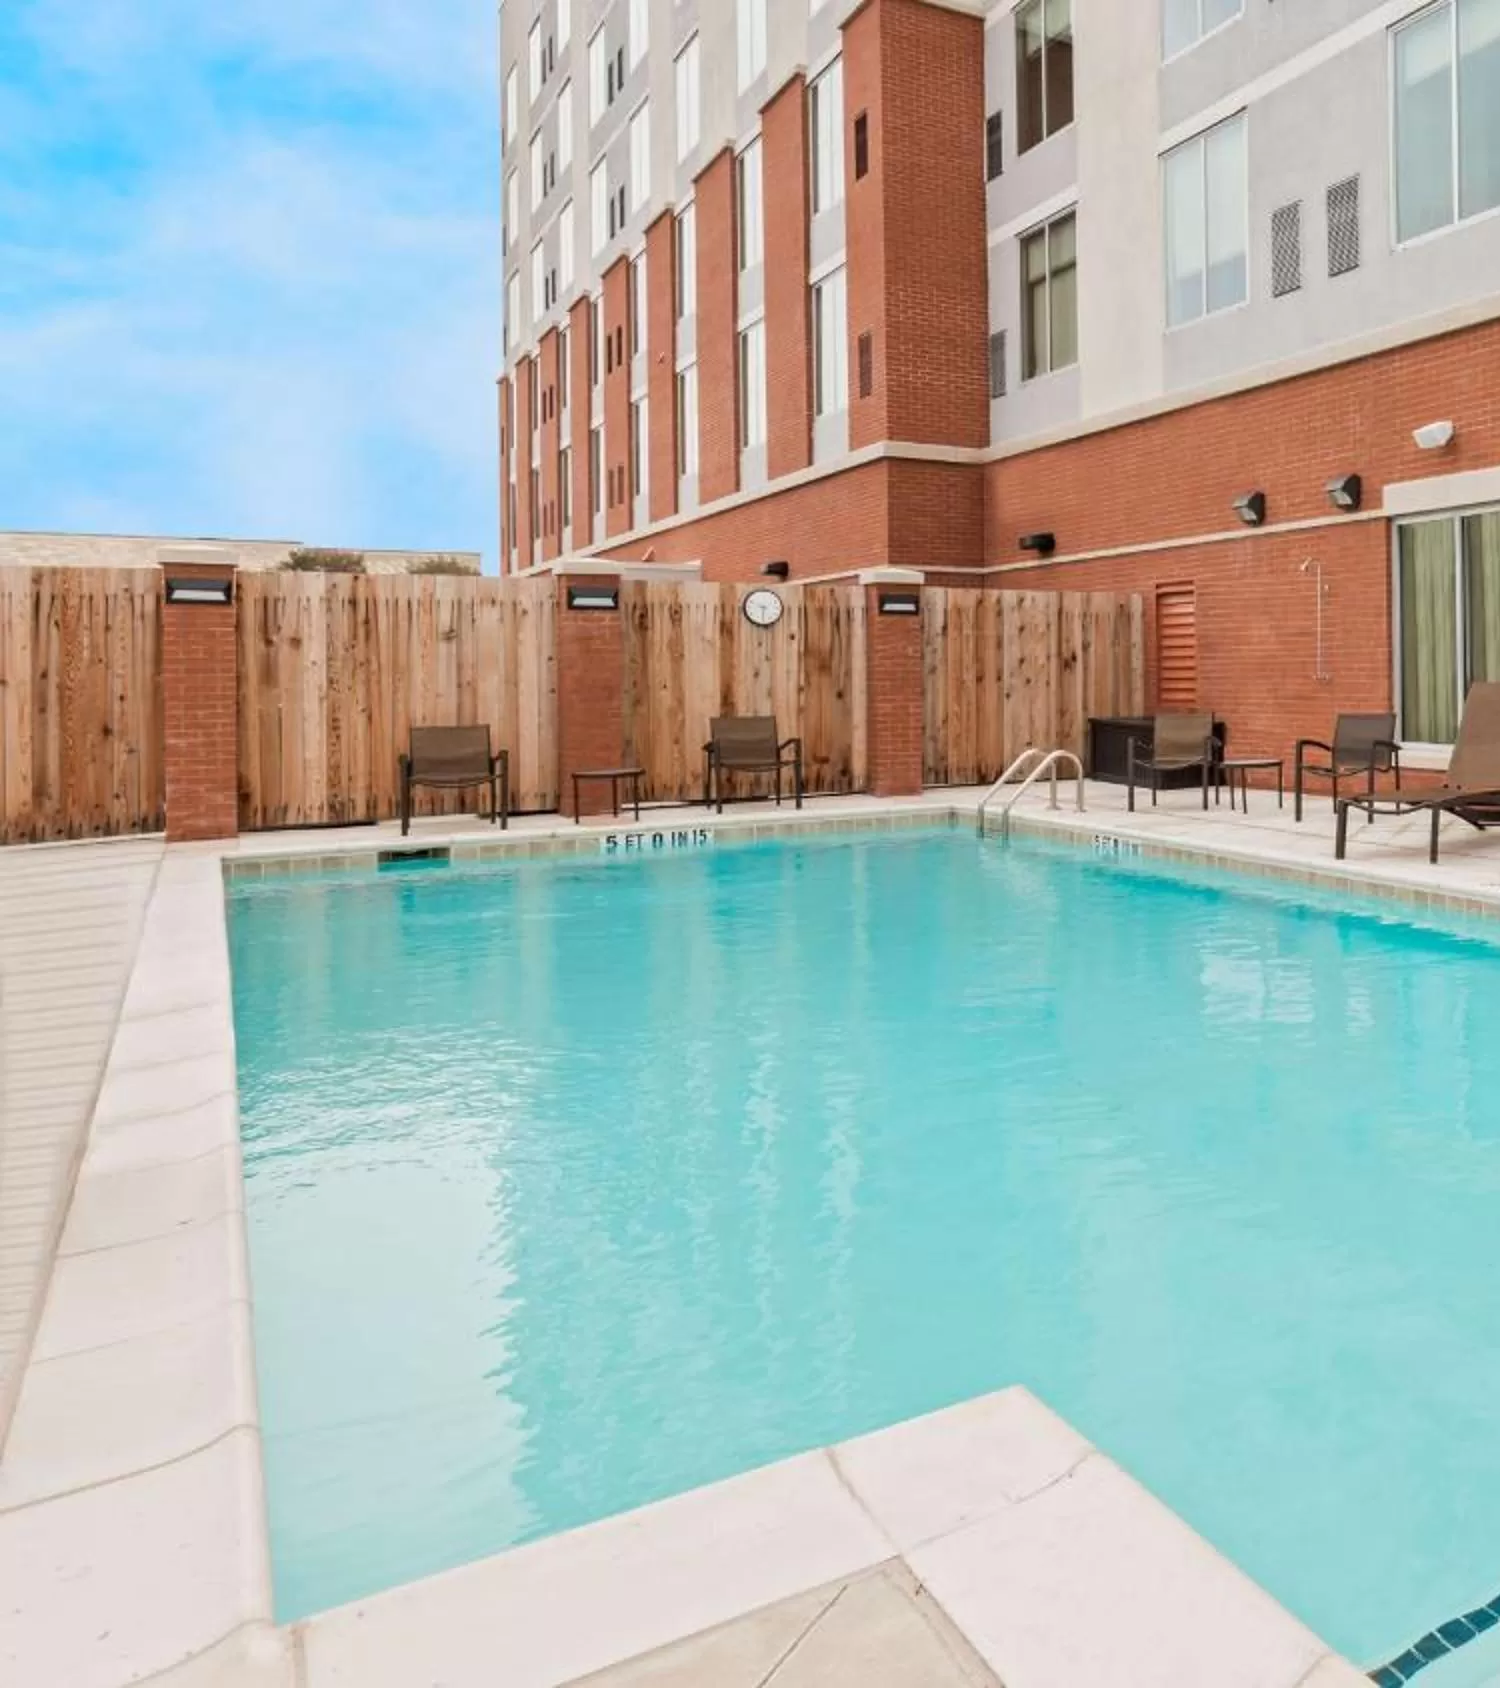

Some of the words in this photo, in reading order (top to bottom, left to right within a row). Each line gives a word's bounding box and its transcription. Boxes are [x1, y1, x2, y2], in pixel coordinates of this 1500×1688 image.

[606, 834, 618, 850] 5
[626, 833, 645, 850] FT
[671, 831, 688, 848] IN
